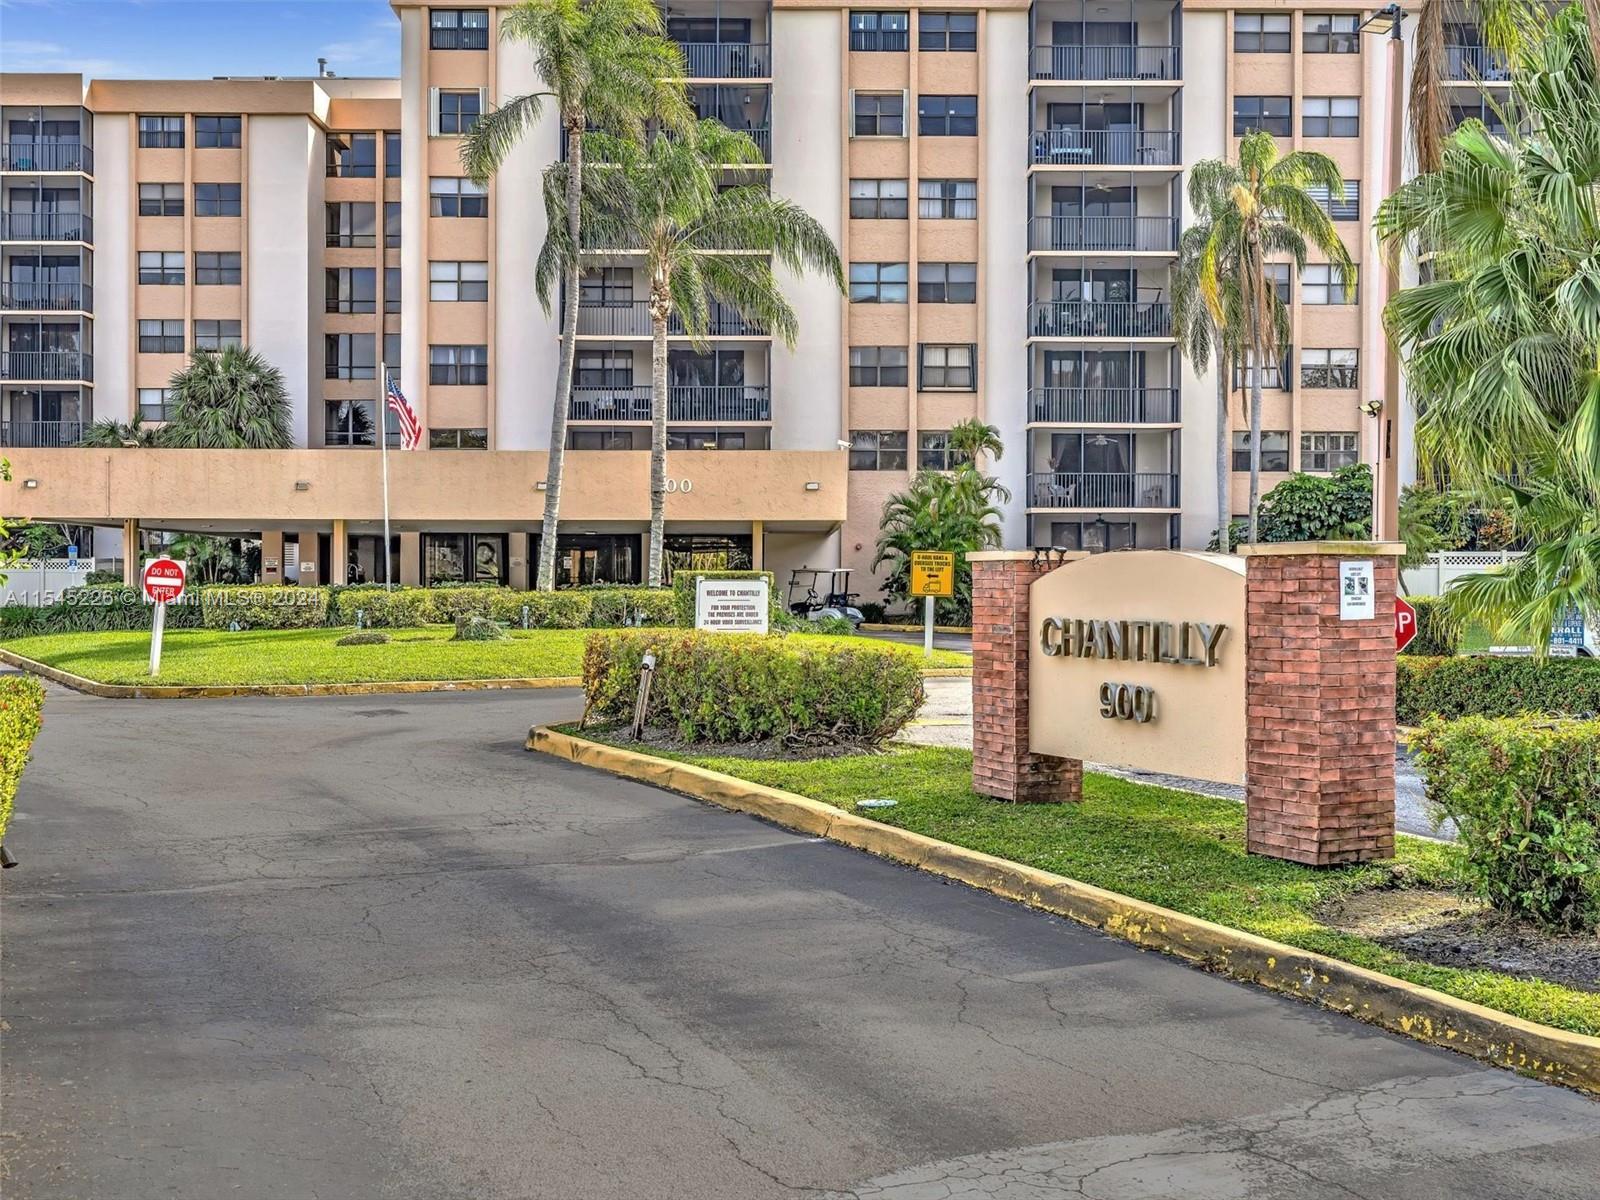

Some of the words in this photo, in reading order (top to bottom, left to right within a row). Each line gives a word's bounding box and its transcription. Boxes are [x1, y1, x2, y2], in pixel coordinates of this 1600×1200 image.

[665, 478, 692, 493] 00
[151, 567, 162, 576] DO
[164, 568, 178, 577] NOT
[152, 586, 175, 596] ENTER
[1040, 616, 1231, 668] CHANTILLY
[1100, 681, 1153, 723] 900
